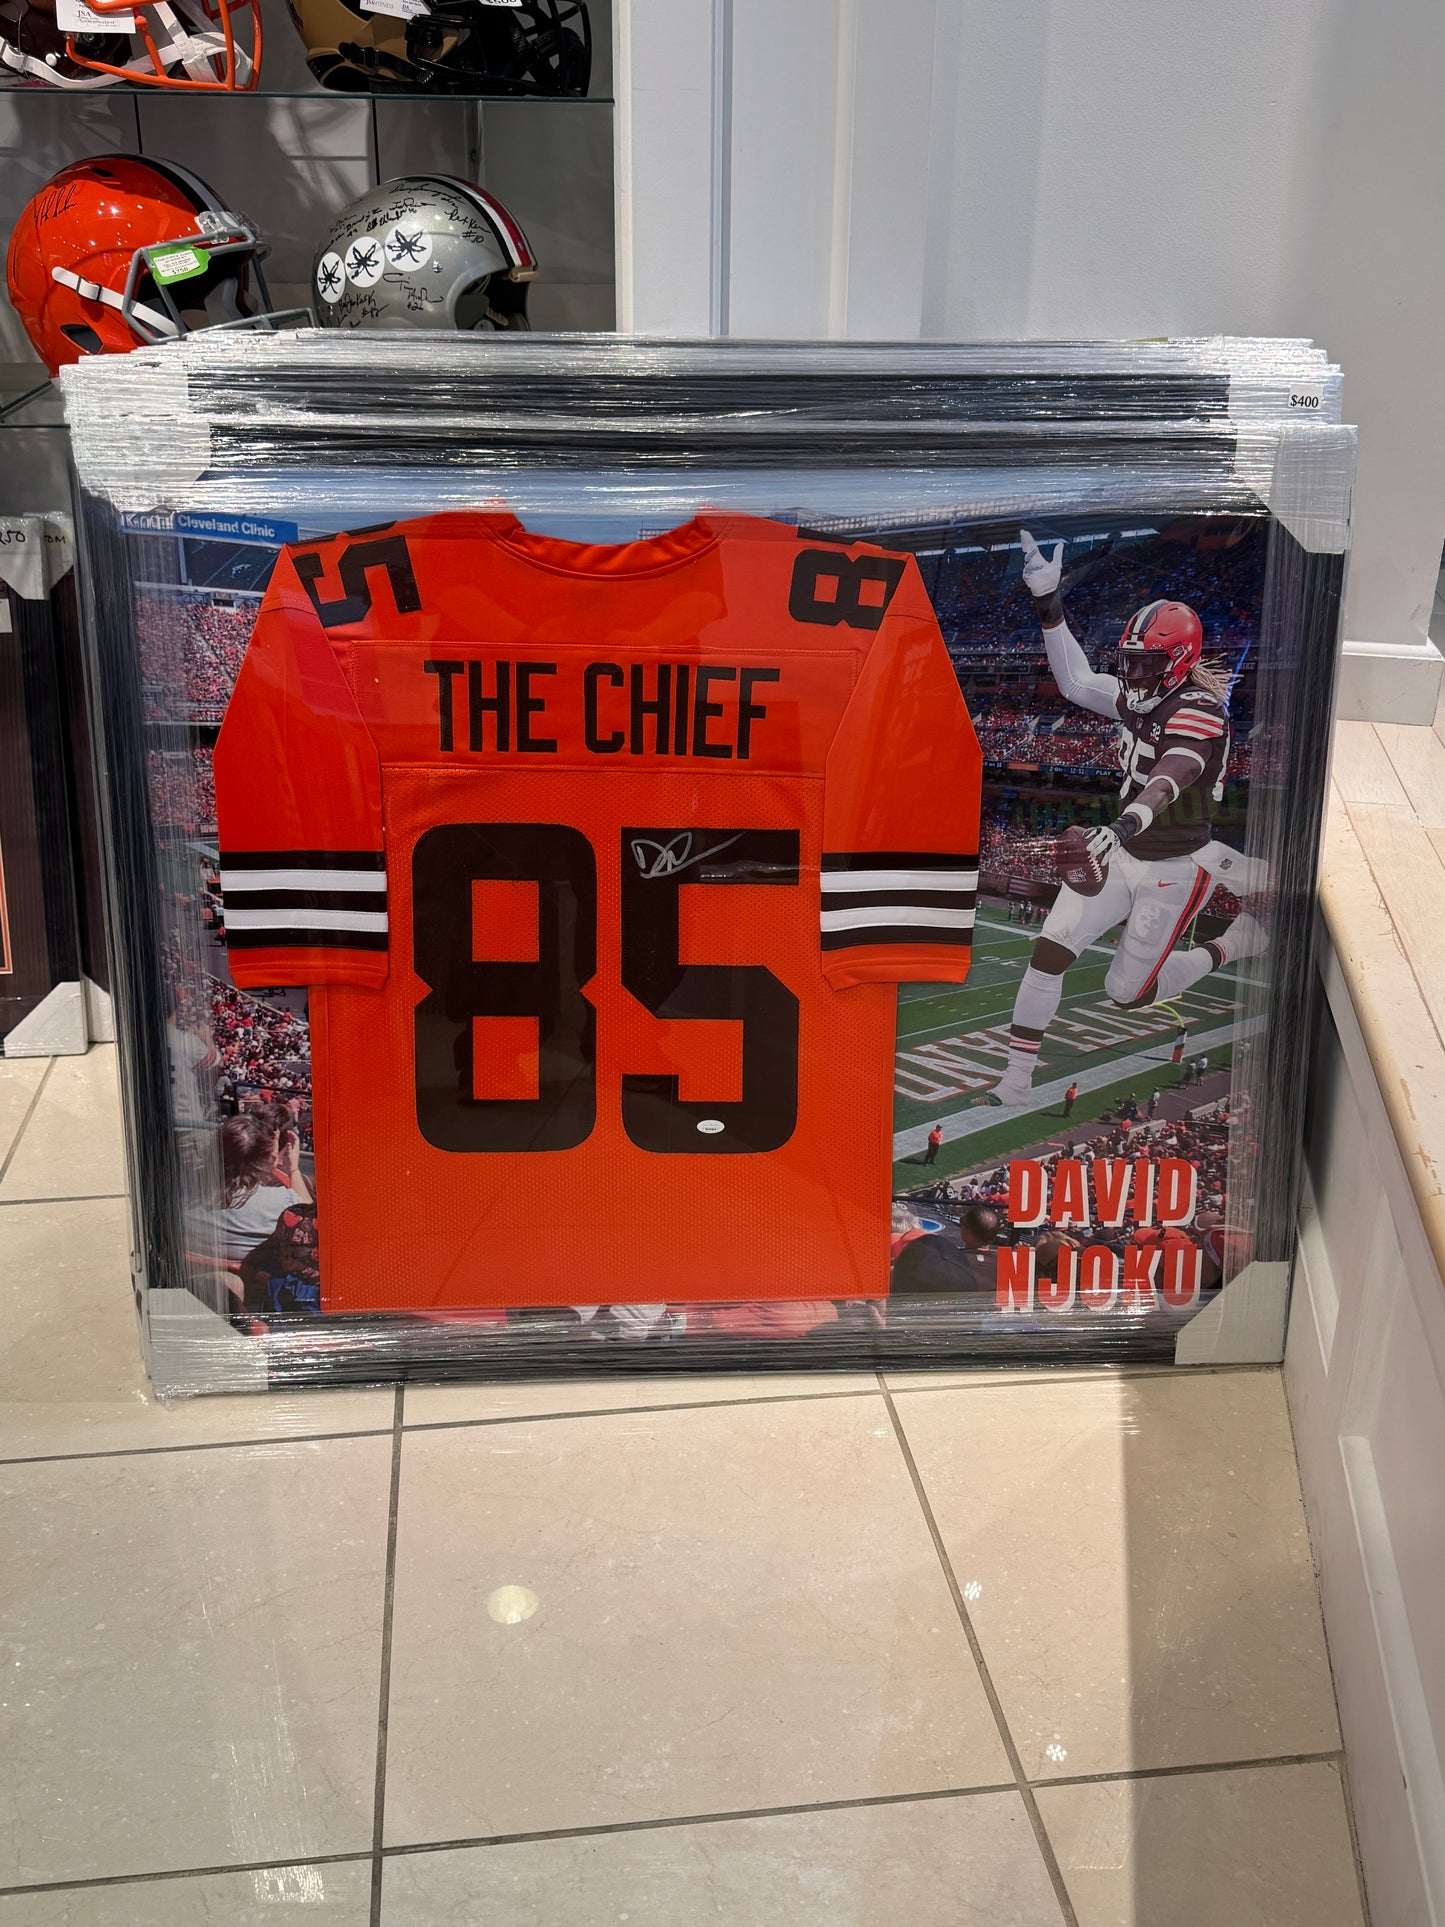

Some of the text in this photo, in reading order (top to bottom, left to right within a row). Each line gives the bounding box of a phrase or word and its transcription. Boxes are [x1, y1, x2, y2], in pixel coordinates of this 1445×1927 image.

[1290, 394, 1319, 408] $400
[178, 514, 239, 534] Cleveland
[241, 522, 276, 538] Clinic
[424, 660, 781, 759] THE CHIEF
[412, 823, 800, 1154] 85
[1008, 1158, 1198, 1228] DAVID
[996, 1244, 1203, 1312] NJOKU
